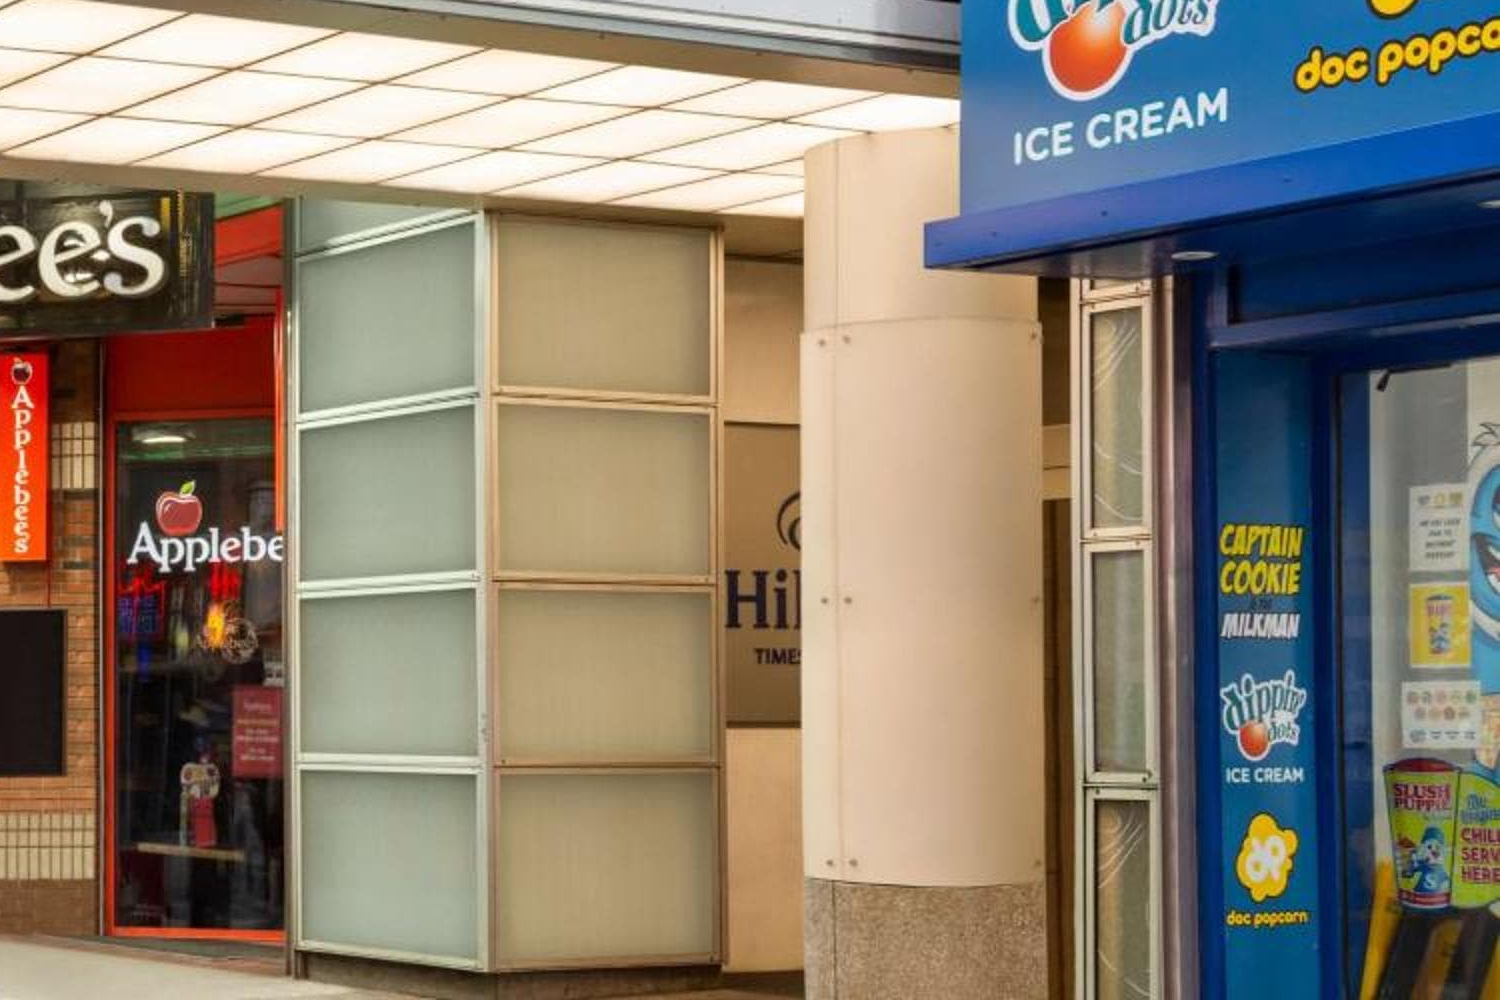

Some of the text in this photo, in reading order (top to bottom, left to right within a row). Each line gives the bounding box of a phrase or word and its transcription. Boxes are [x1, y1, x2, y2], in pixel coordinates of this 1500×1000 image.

[1294, 45, 1369, 93] doc
[1013, 88, 1228, 167] ICE CREAM
[127, 521, 284, 573] Applebe
[1220, 523, 1303, 558] CAPTAIN
[1220, 560, 1301, 595] COOKIE
[1220, 613, 1301, 639] MILKMAN
[1226, 767, 1304, 783] ICE CREAM
[1395, 783, 1451, 799] SLUSH
[1461, 827, 1500, 844] CHIL
[1226, 910, 1309, 929] doc popcorn
